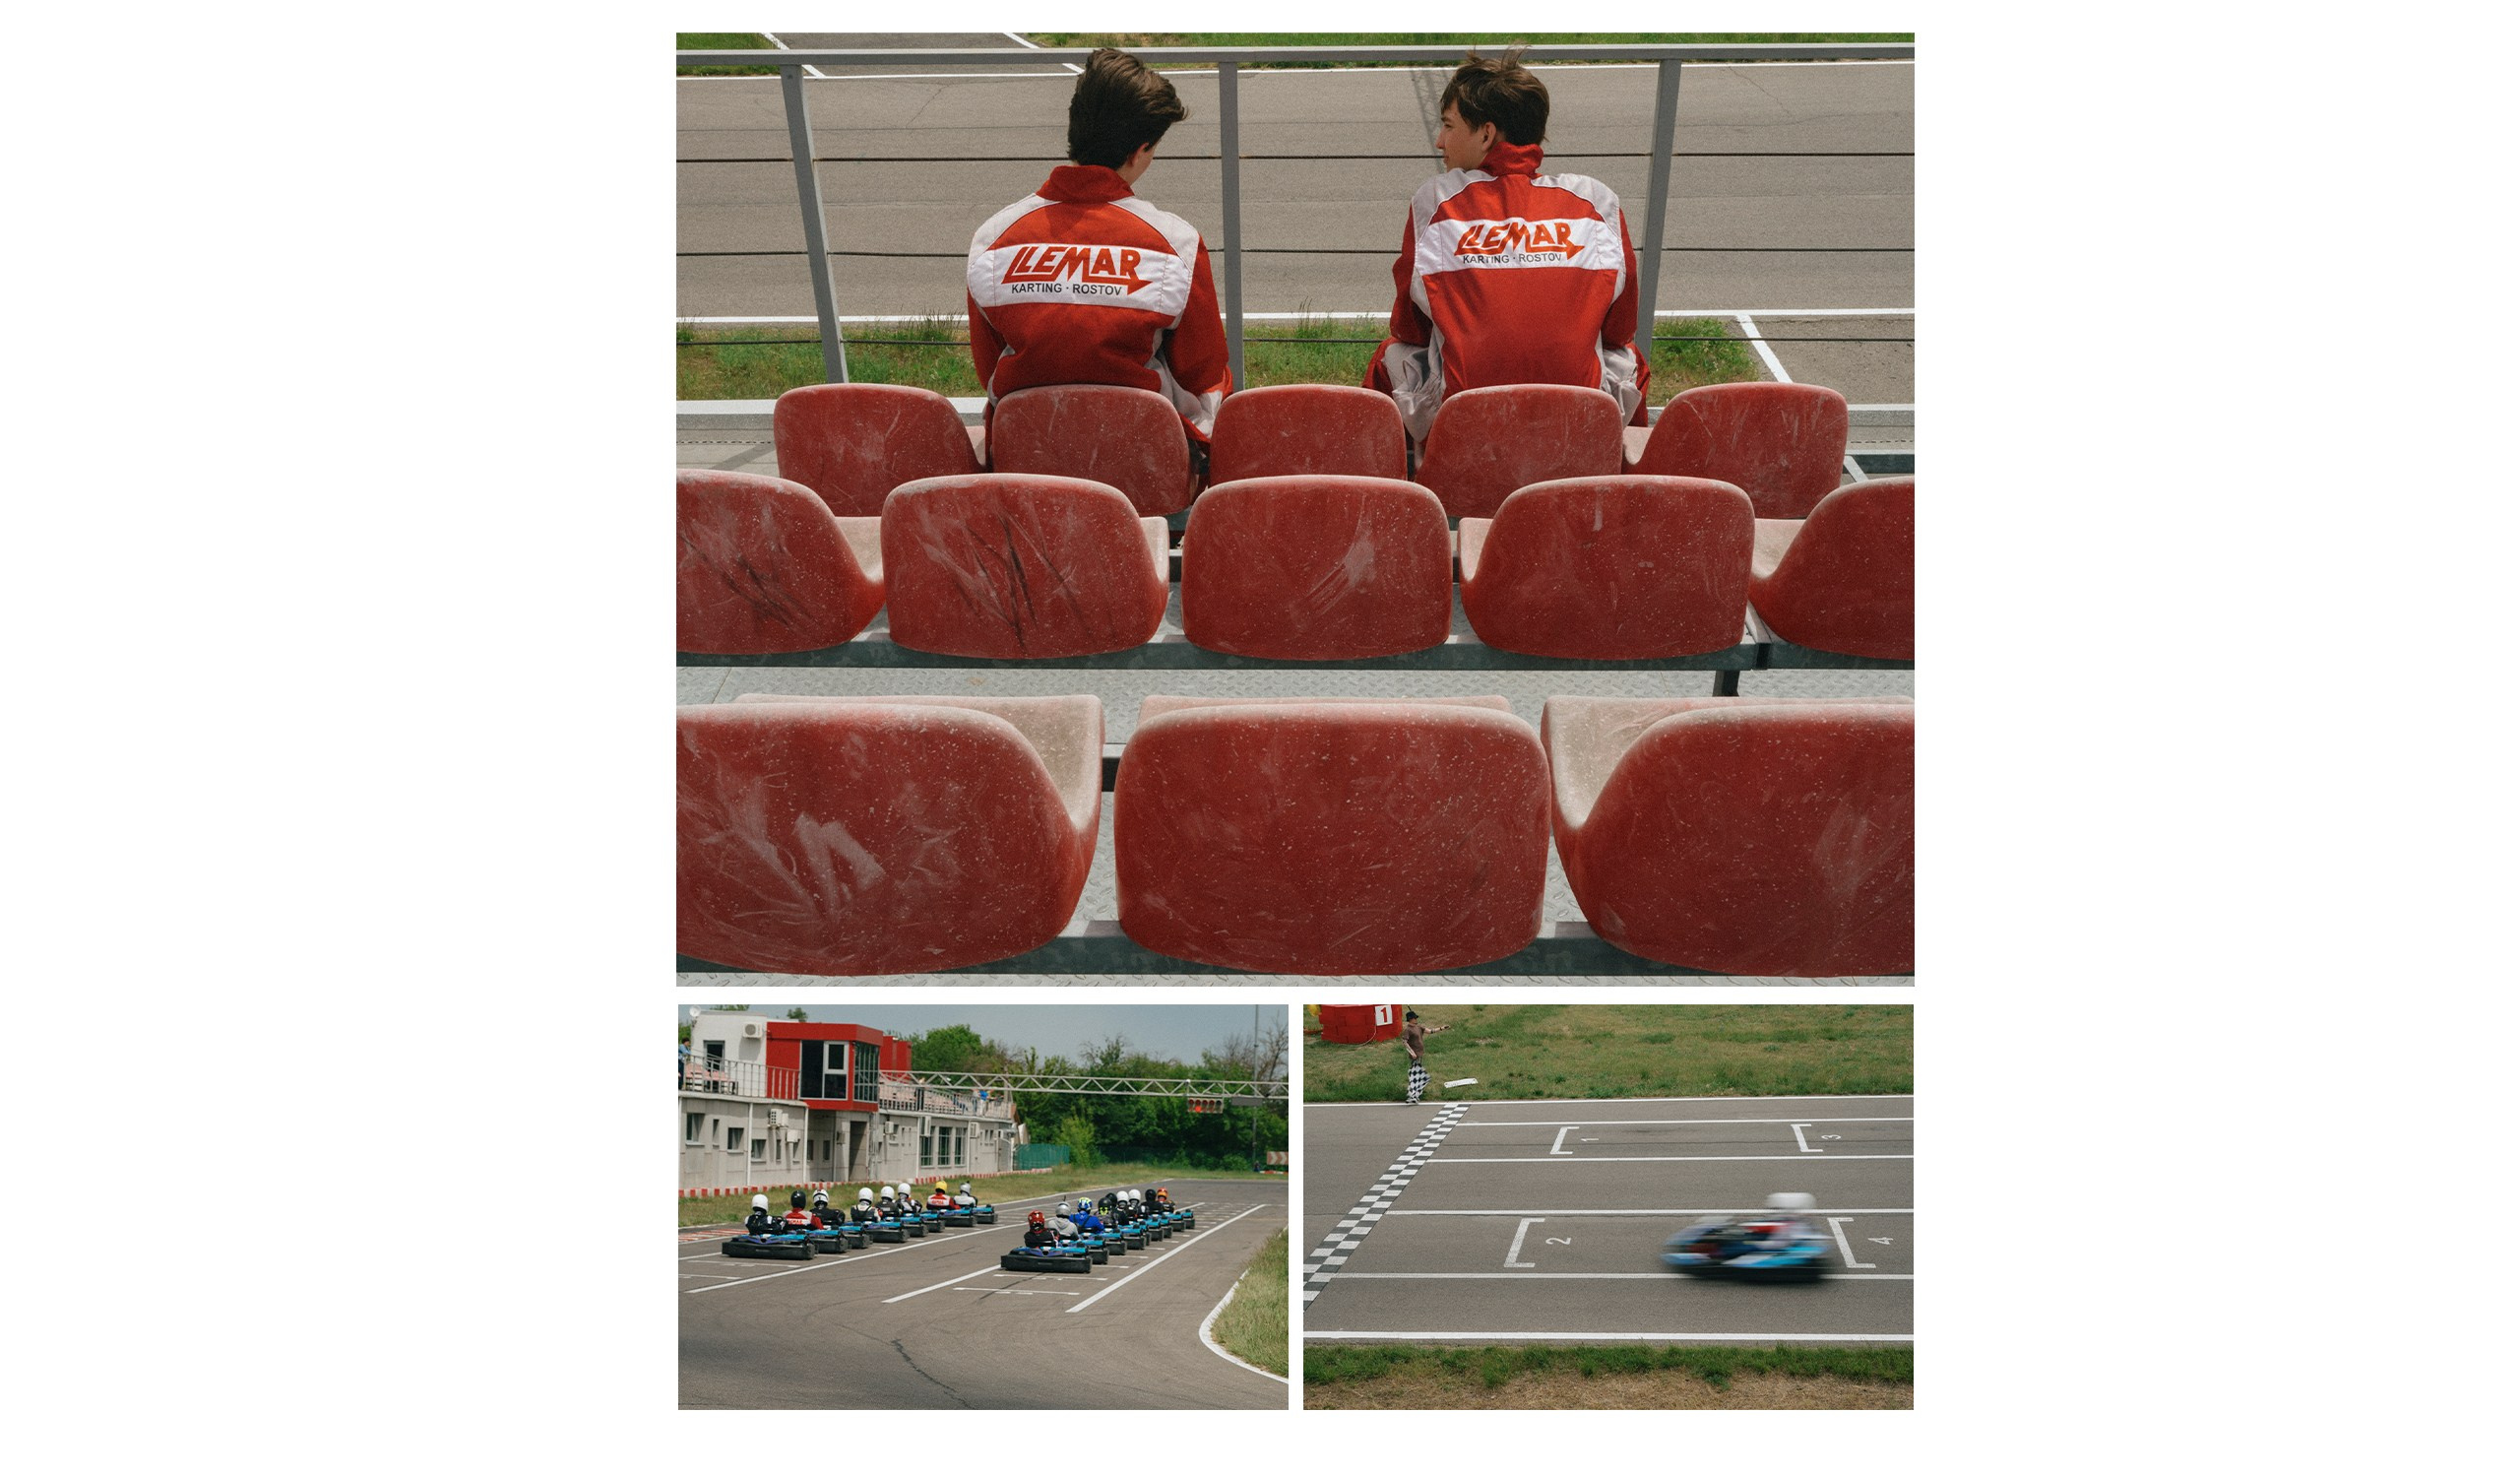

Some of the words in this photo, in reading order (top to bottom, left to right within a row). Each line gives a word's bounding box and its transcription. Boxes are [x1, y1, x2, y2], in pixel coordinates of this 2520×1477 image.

[1463, 254, 1510, 264] KARTING
[1519, 252, 1562, 263] ROSTOV
[1011, 283, 1062, 294] KARTING
[1072, 283, 1122, 295] ROSTOV
[1380, 1006, 1388, 1023] 1
[1544, 1237, 1572, 1246] 2
[1867, 1237, 1894, 1246] 4
